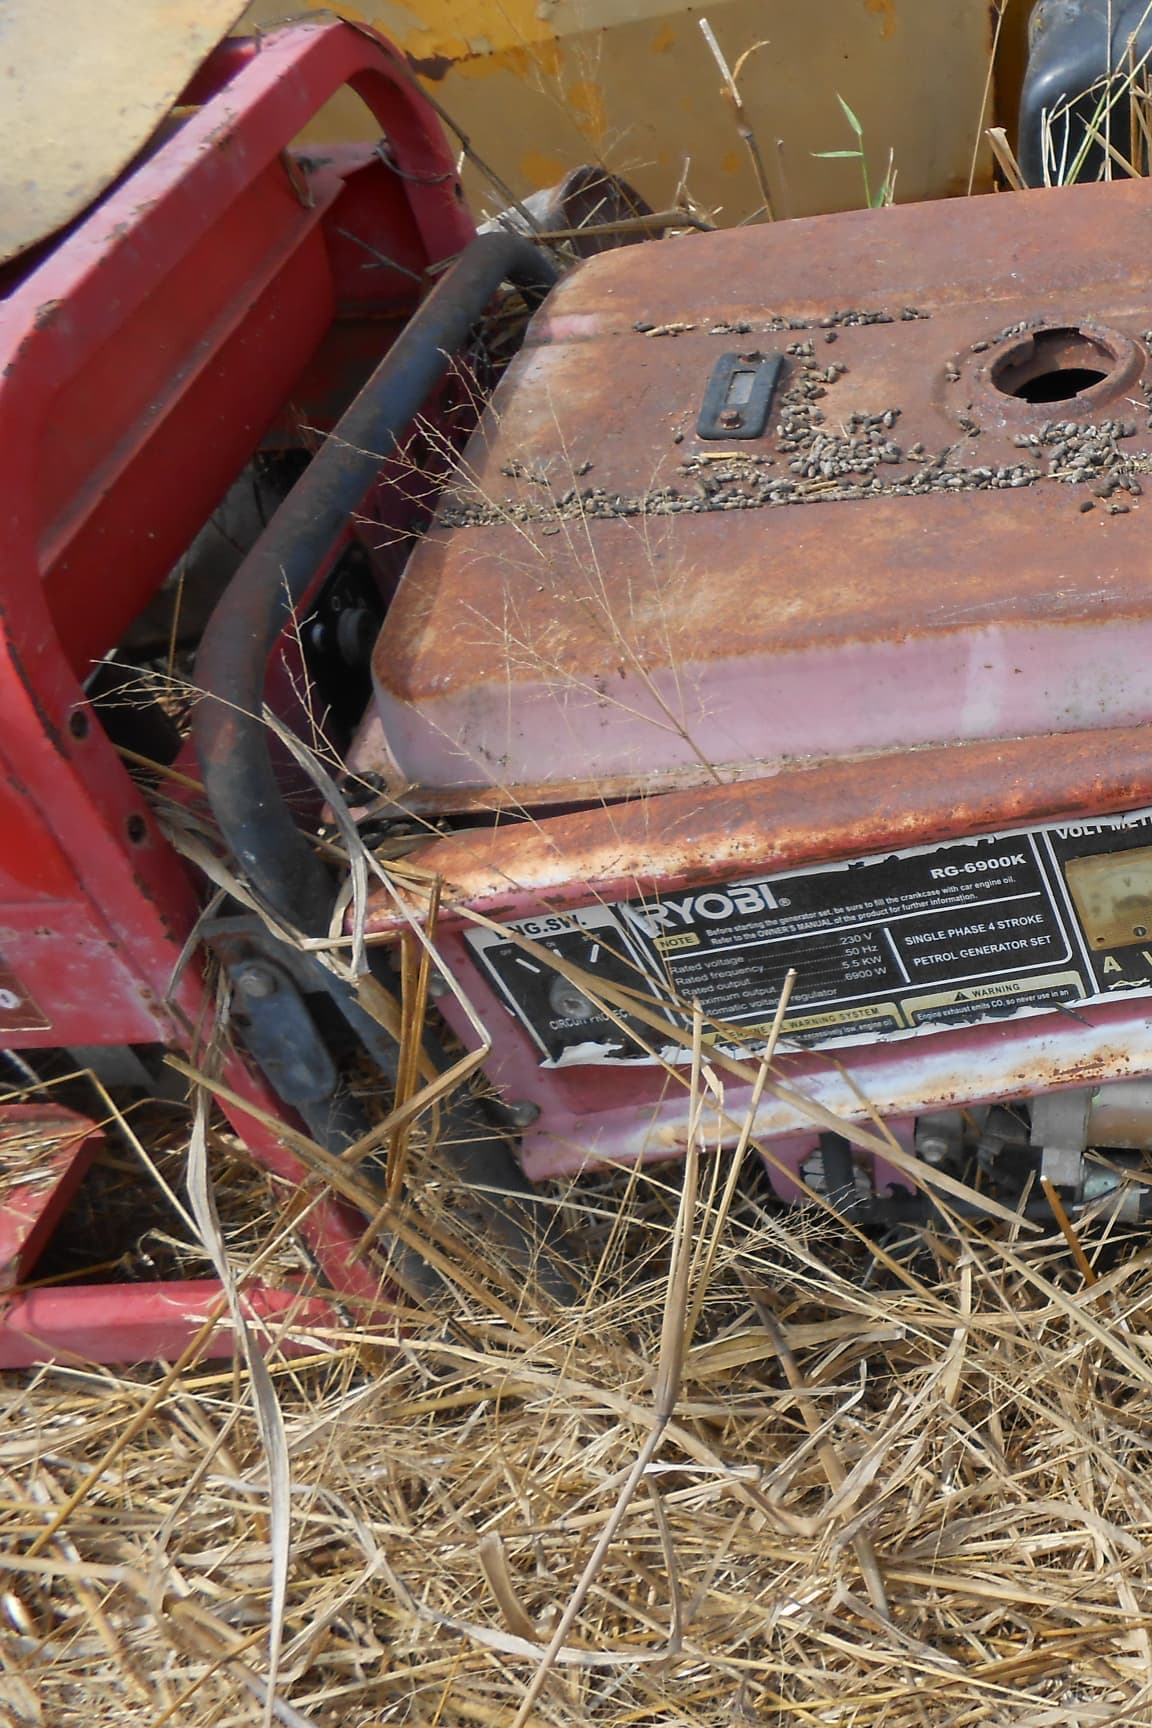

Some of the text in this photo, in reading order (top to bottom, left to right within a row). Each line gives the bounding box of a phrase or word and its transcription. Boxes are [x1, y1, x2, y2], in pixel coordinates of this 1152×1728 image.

[1056, 825, 1104, 840] VOLT
[930, 852, 1027, 880] RG-6900K
[632, 884, 778, 929] RYOBI
[706, 926, 734, 938] Before
[734, 921, 765, 935] starting
[765, 918, 778, 928] the
[778, 912, 817, 926] generator
[834, 905, 845, 915] be
[846, 904, 864, 913] sure
[864, 901, 874, 910] to
[874, 898, 885, 907] fill
[886, 896, 900, 905] the
[901, 889, 941, 903] crankcase
[941, 885, 960, 896] with
[960, 883, 973, 892] car
[975, 879, 1003, 891] engine
[1003, 876, 1016, 885] oil.
[710, 893, 979, 947] Refer to the OWNER'S MANUAL of the product for further information.
[660, 935, 694, 948] NOTE
[904, 914, 1045, 947] SINGLE PHASE 4 STROKE
[671, 932, 873, 975] Rated voltage 230 V
[675, 944, 878, 986] Rated frequency 50 Hz
[913, 935, 1052, 967] PETROL GENERATOR SET
[681, 955, 882, 997] Rated output 5.5 KW
[688, 966, 888, 1007] aximum output 6900 W
[972, 983, 1021, 998] WARNING
[790, 988, 838, 1002] regulator
[917, 1010, 943, 1022] Engine
[943, 1005, 971, 1018] exhaust
[971, 1002, 991, 1013] emits
[1006, 997, 1016, 1006] so
[1016, 994, 1037, 1004] never
[1037, 992, 1051, 1001] use
[1051, 990, 1059, 999] in
[1059, 989, 1069, 998] an
[788, 1014, 837, 1030] WARNING
[839, 1007, 880, 1023] SYSTEM
